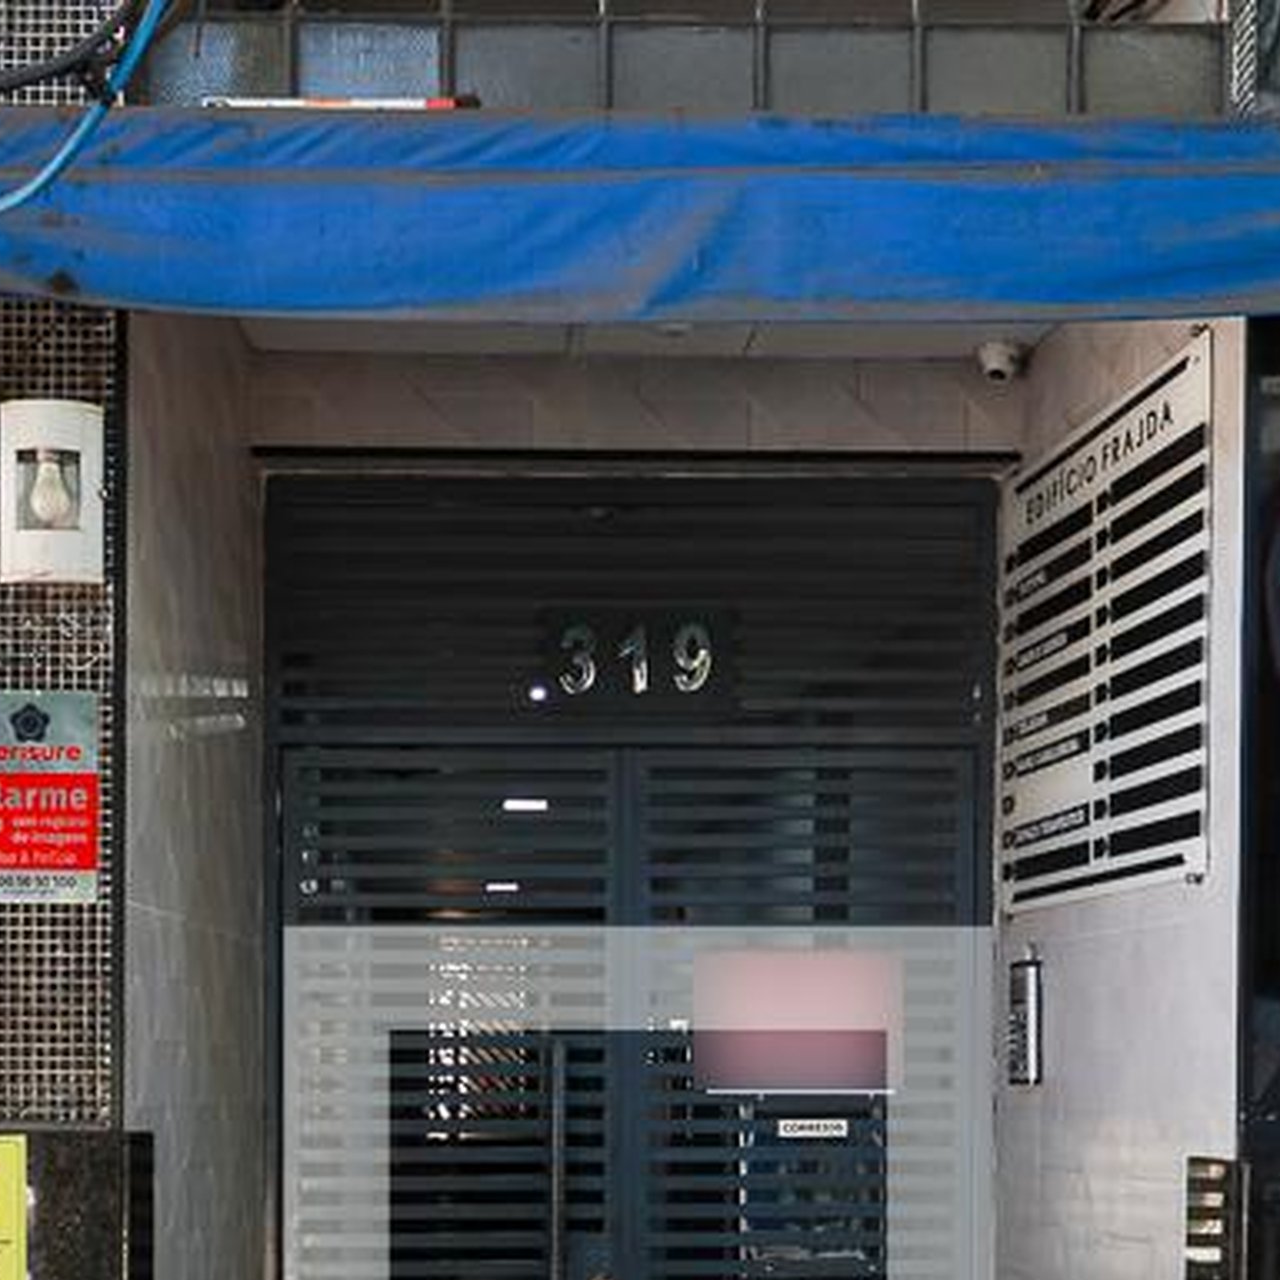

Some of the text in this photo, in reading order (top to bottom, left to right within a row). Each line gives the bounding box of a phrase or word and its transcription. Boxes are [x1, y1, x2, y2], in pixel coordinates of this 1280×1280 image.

[1024, 401, 1175, 525] EDIFÍCIO FRAJDA
[558, 622, 712, 695] 319
